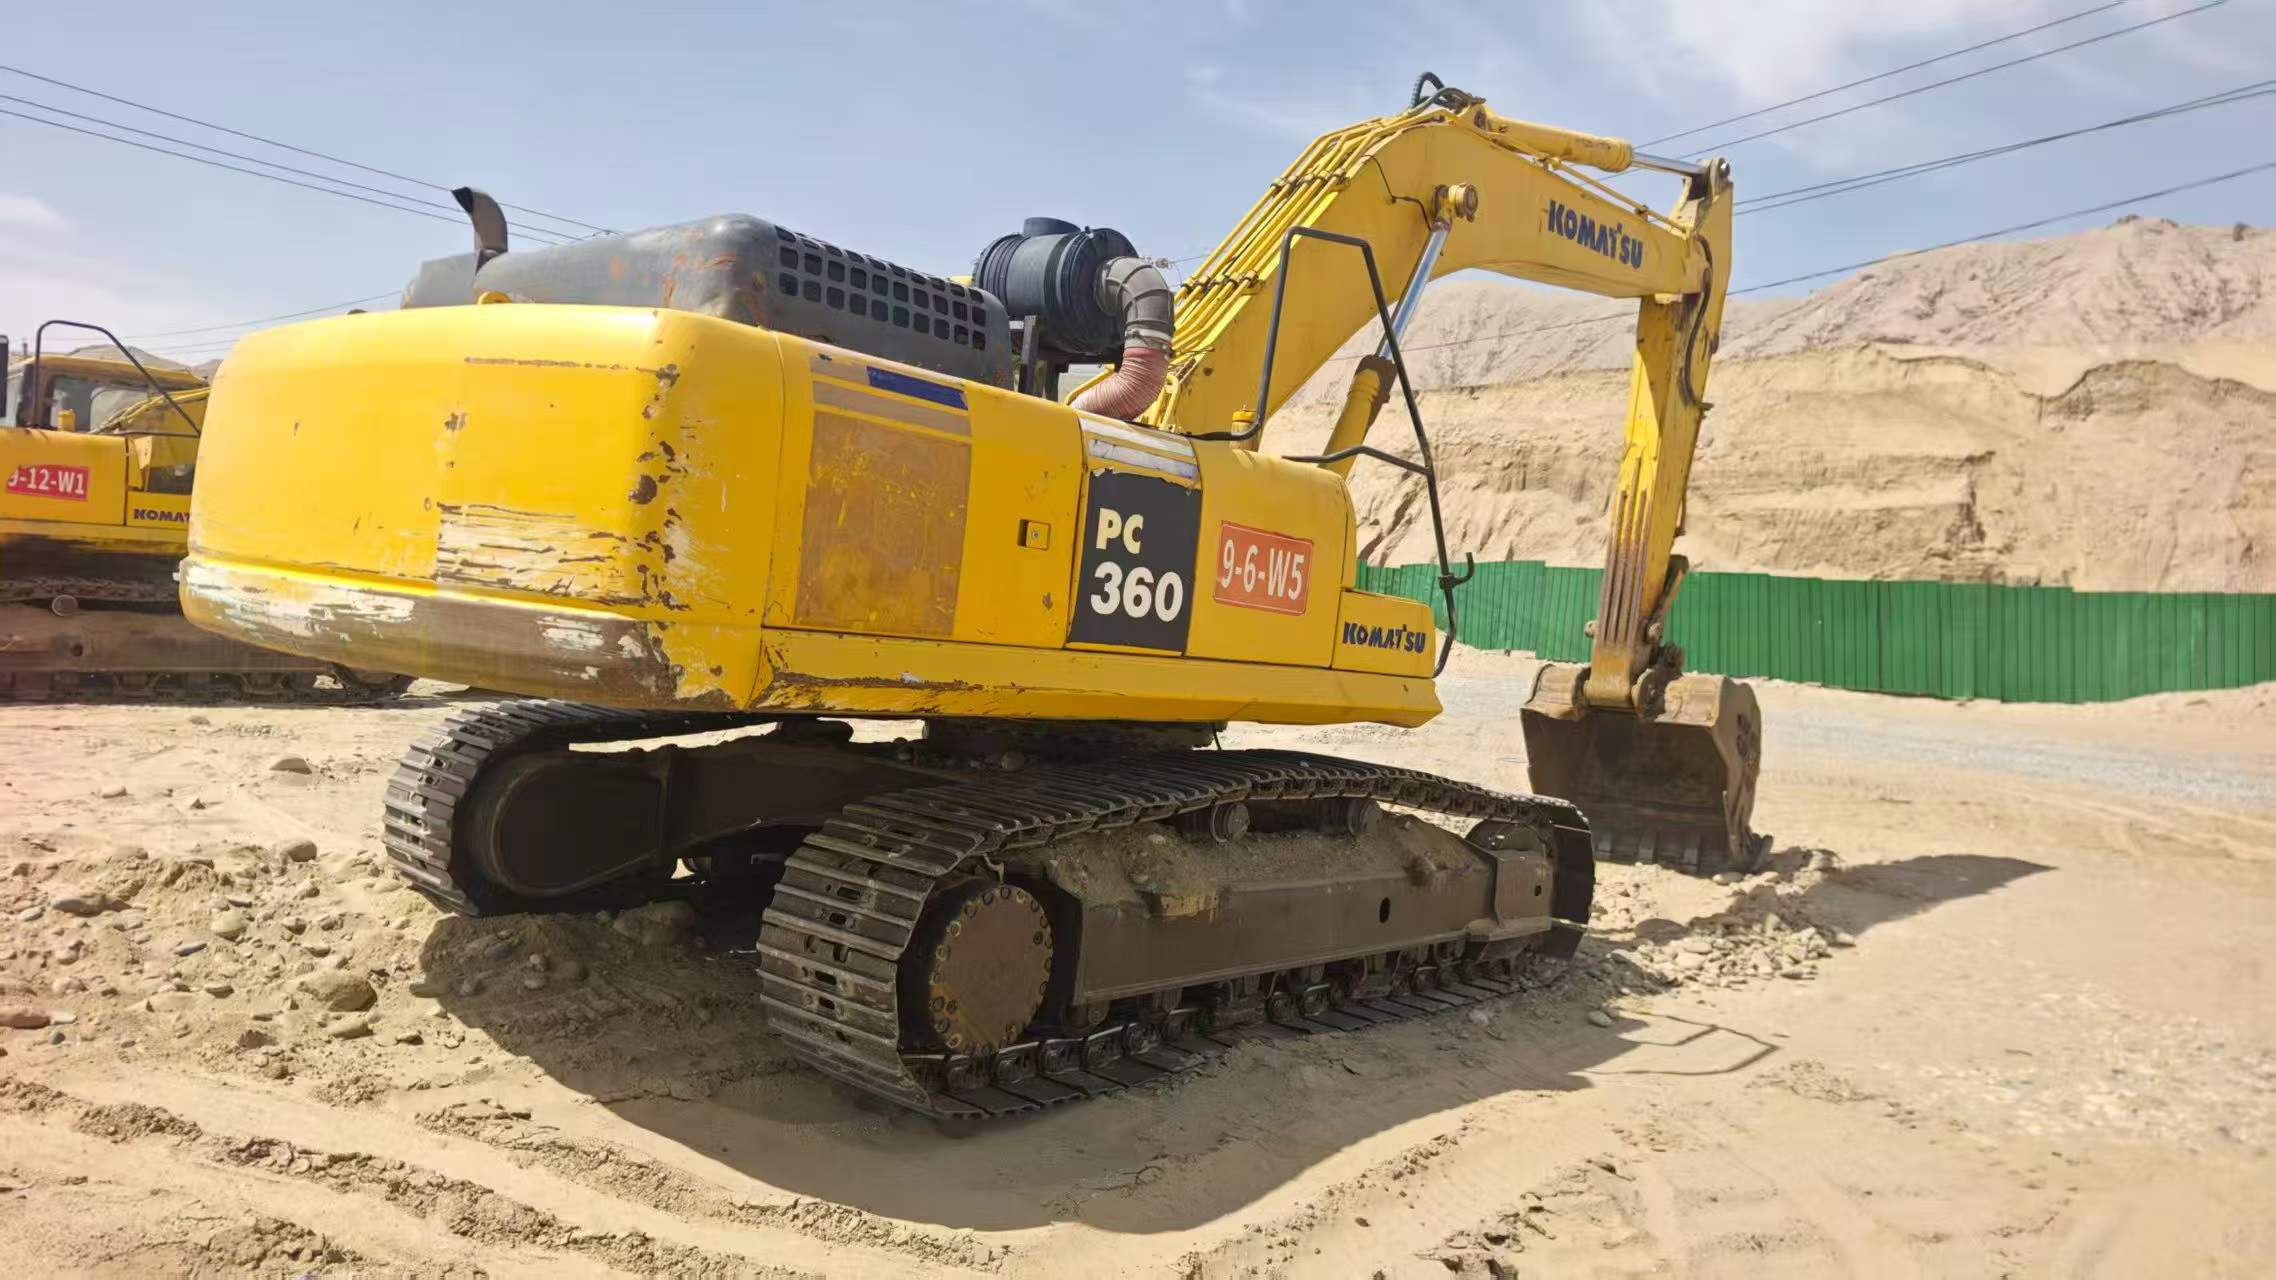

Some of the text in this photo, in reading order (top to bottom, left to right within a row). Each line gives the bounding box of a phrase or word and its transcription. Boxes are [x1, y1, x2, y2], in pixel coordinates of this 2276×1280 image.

[1548, 199, 1643, 269] KOMATSU
[134, 508, 190, 523] KOMAT
[1095, 507, 1144, 554] PC
[1090, 561, 1183, 622] 360
[1220, 538, 1305, 601] 9-6-W5
[1342, 621, 1426, 654] KOMATSU
